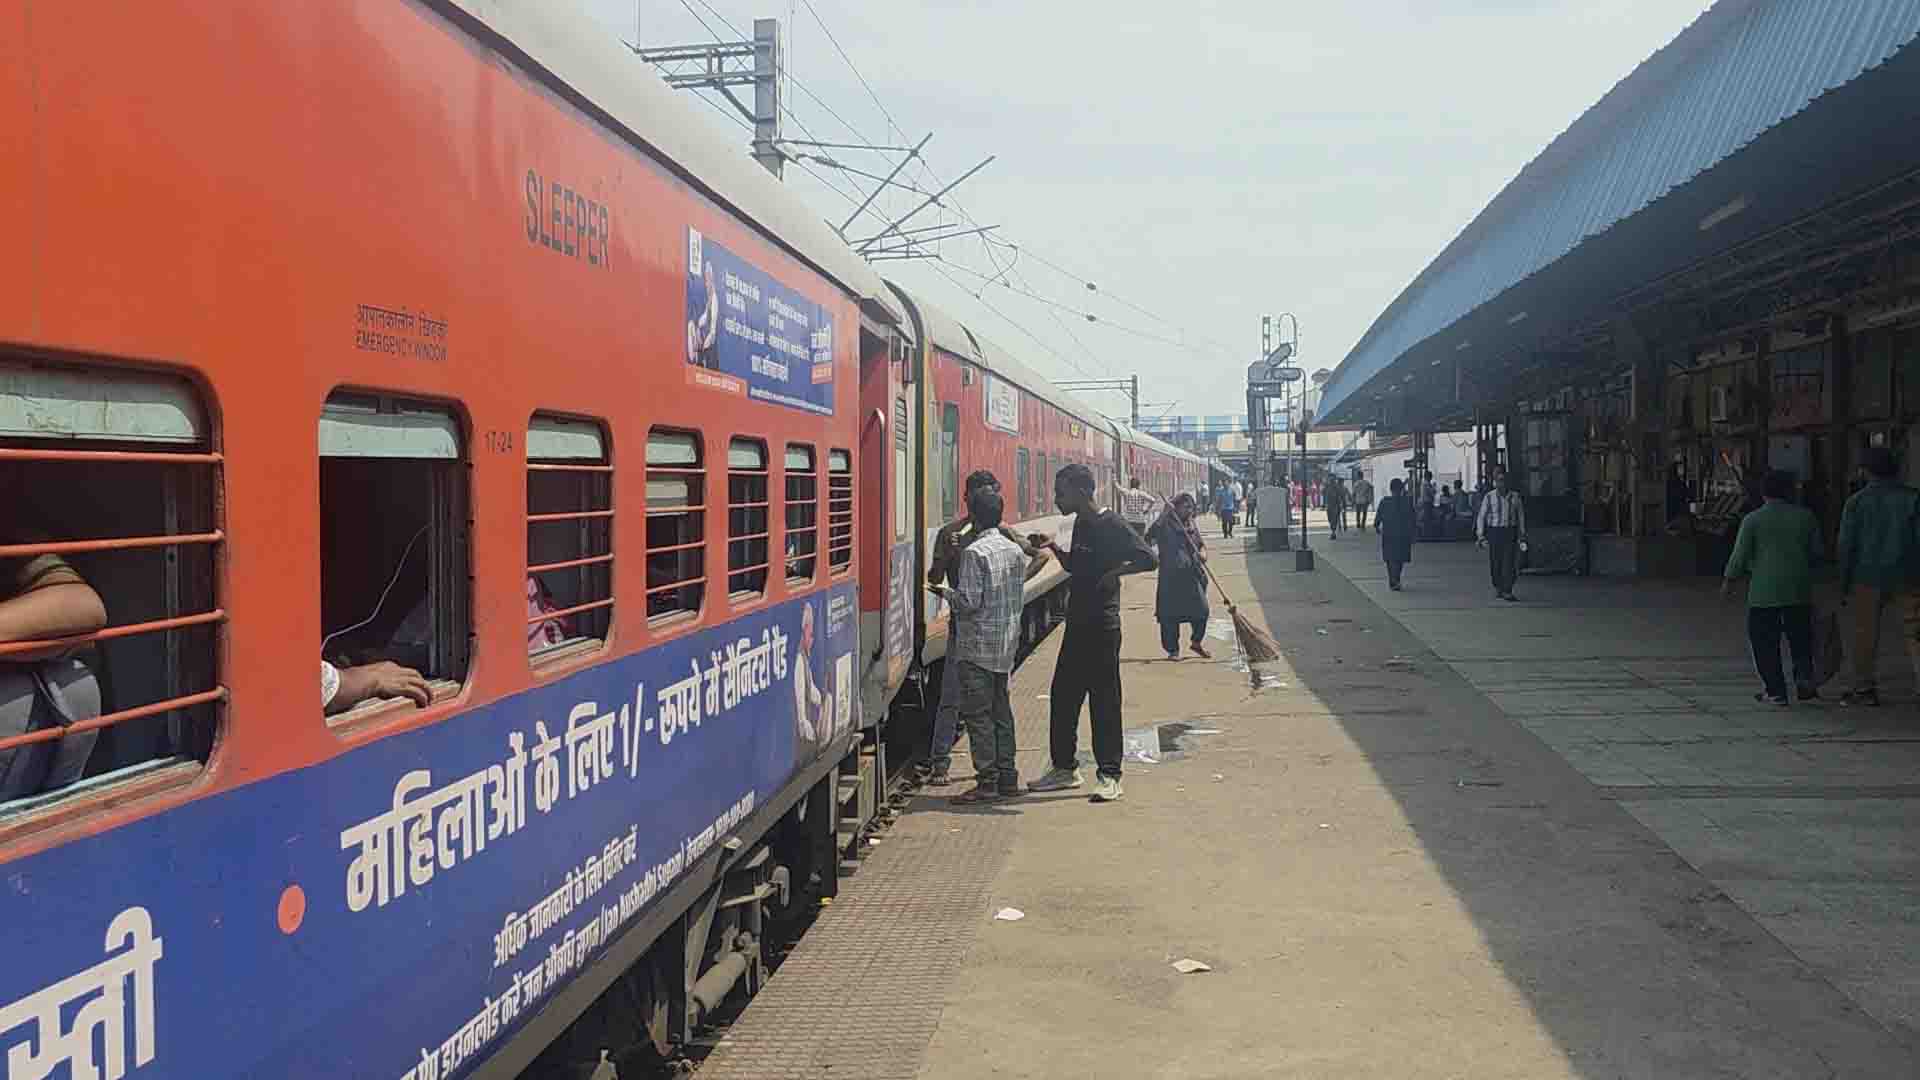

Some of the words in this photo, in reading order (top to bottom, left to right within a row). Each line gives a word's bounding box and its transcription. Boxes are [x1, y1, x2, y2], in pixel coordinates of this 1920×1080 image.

[526, 169, 610, 267] SLEEPER
[356, 330, 415, 358] EMERGENCY
[415, 344, 448, 361] WINDOW
[485, 431, 513, 452] 17-24
[340, 731, 527, 912] महिलाओं
[531, 720, 561, 815] के
[566, 701, 614, 799] लिए
[619, 682, 655, 778] 1/-
[704, 649, 722, 716] में
[722, 628, 771, 710] सैनिटरी
[772, 624, 788, 681] पैड
[493, 912, 528, 968] अधिक
[528, 872, 574, 940] जानकारी
[574, 866, 585, 905] के
[585, 856, 602, 899] लिए
[623, 824, 638, 865] करें
[440, 997, 500, 1078] डाउनलोड
[501, 969, 522, 1025] करें
[522, 962, 544, 1006] जन
[544, 929, 576, 988] औषधि
[576, 916, 600, 968] सुगम
[618, 865, 657, 924] Aushadhi
